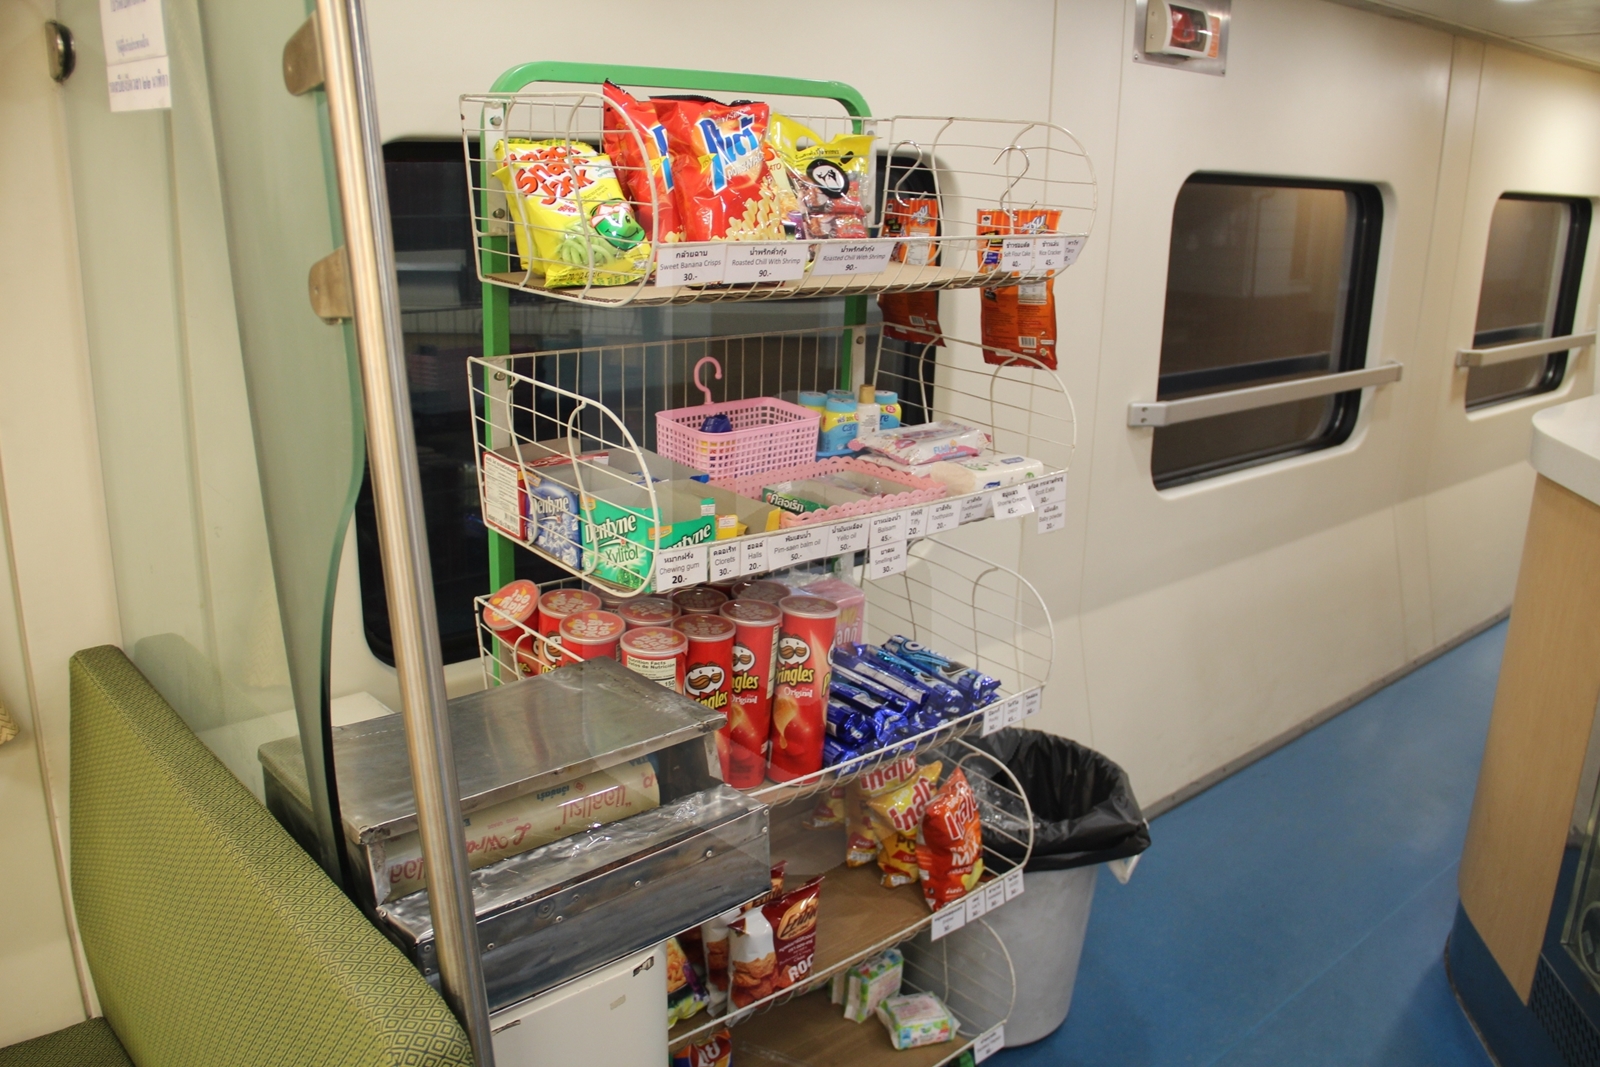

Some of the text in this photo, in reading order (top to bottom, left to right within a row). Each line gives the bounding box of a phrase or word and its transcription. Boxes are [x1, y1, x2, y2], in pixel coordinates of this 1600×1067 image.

[680, 261, 703, 269] Banana
[703, 259, 722, 268] Crisps
[782, 257, 801, 265] Shrimp
[683, 272, 698, 281] 30.-
[758, 269, 772, 277] 90.-
[842, 423, 858, 433] car
[1048, 512, 1063, 520] powder
[585, 514, 637, 544] Dentyne
[877, 525, 897, 533] Balsam
[908, 527, 920, 536] 20.-
[836, 534, 850, 542] Yello
[880, 534, 892, 542] 45.-
[774, 538, 822, 554] Pim-saen balm oil
[839, 543, 852, 551] 50.-
[604, 545, 640, 568] Xylitol
[747, 552, 763, 560] Halls
[790, 553, 803, 561] 50.-
[714, 556, 736, 566] Clorets
[874, 557, 893, 566] Smelling
[659, 562, 700, 575] Chewing gum
[748, 562, 761, 571] 20.-
[718, 567, 732, 577] 30.-
[672, 574, 688, 584] 20.-
[783, 686, 814, 699] Original
[465, 833, 510, 854] Wra
